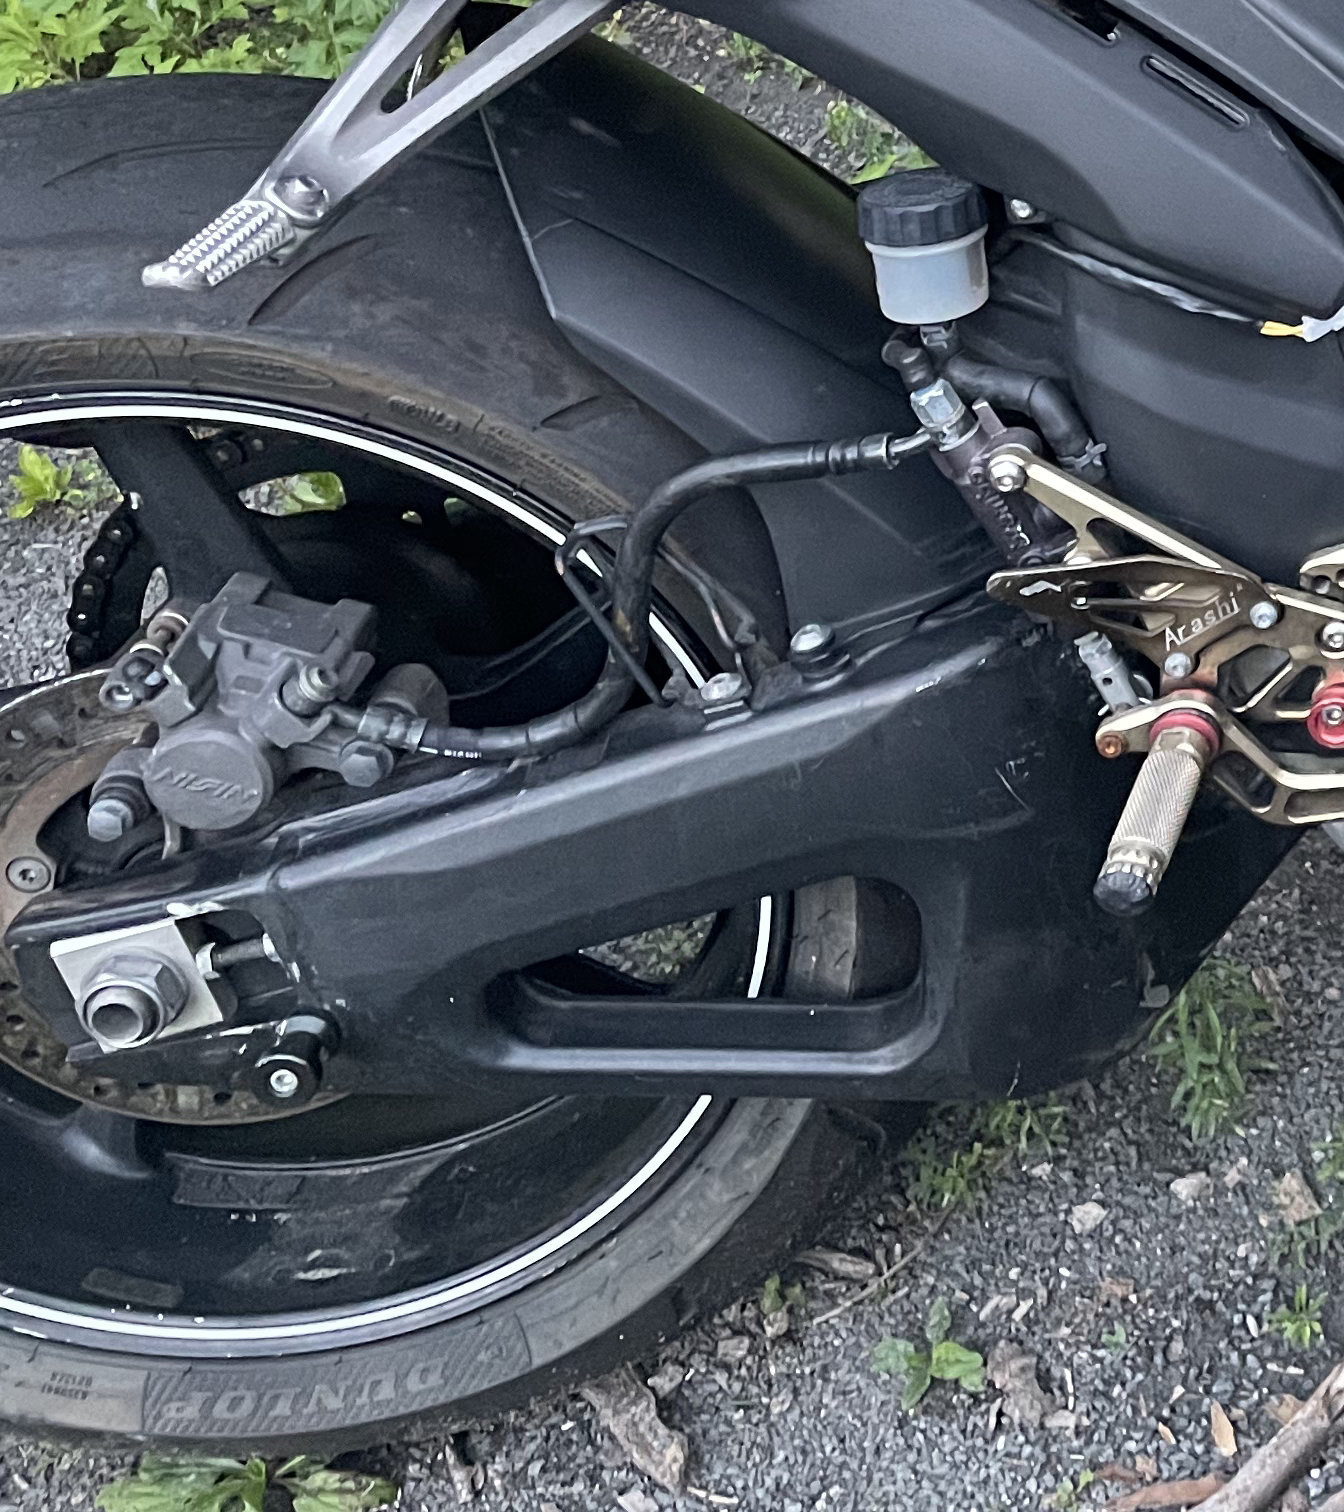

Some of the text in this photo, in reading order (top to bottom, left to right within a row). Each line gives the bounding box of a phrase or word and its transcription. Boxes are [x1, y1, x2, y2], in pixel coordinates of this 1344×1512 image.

[1164, 590, 1241, 652] Arashi
[150, 766, 260, 804] NISSIN
[160, 1356, 452, 1420] DUNLOP
